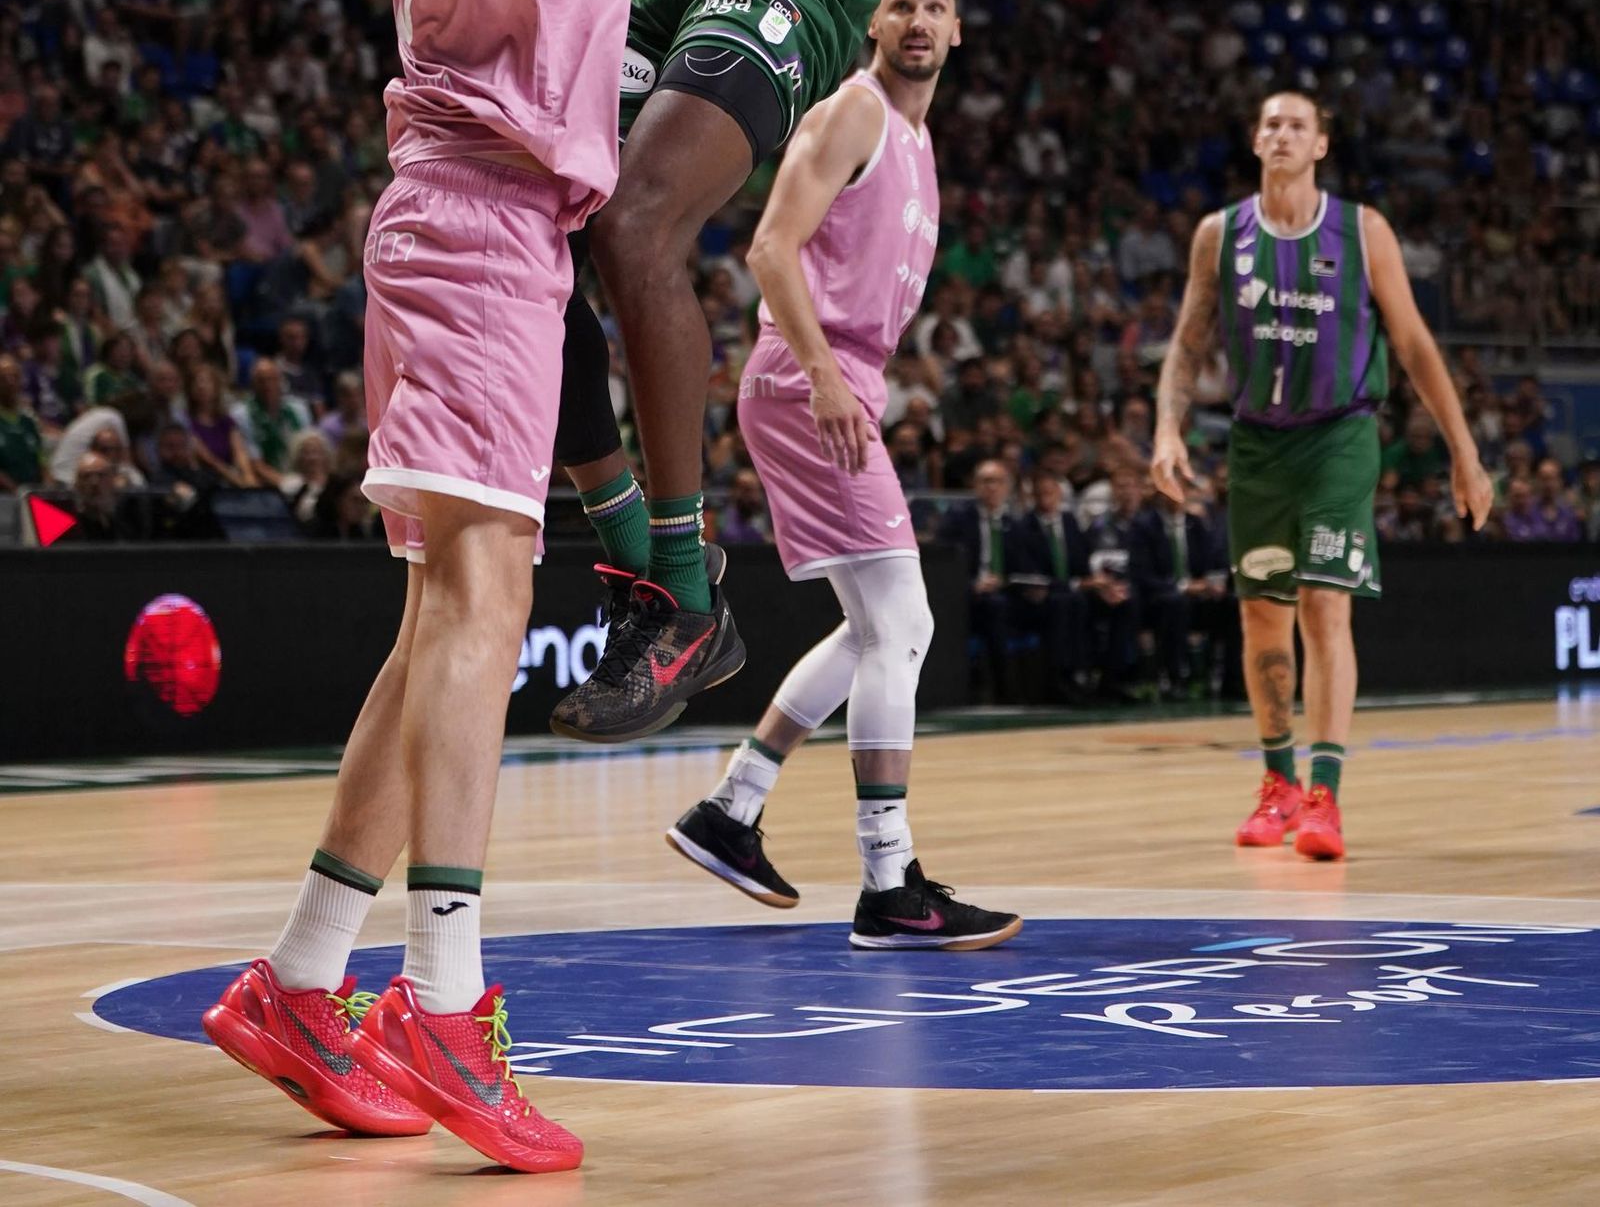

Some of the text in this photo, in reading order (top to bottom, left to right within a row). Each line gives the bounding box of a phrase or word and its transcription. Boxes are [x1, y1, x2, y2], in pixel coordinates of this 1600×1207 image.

[773, 1, 793, 21] acb
[1253, 318, 1318, 347] máaga
[1272, 366, 1284, 405] 1
[1555, 606, 1600, 670] PL
[1061, 964, 1539, 1039] Resort
